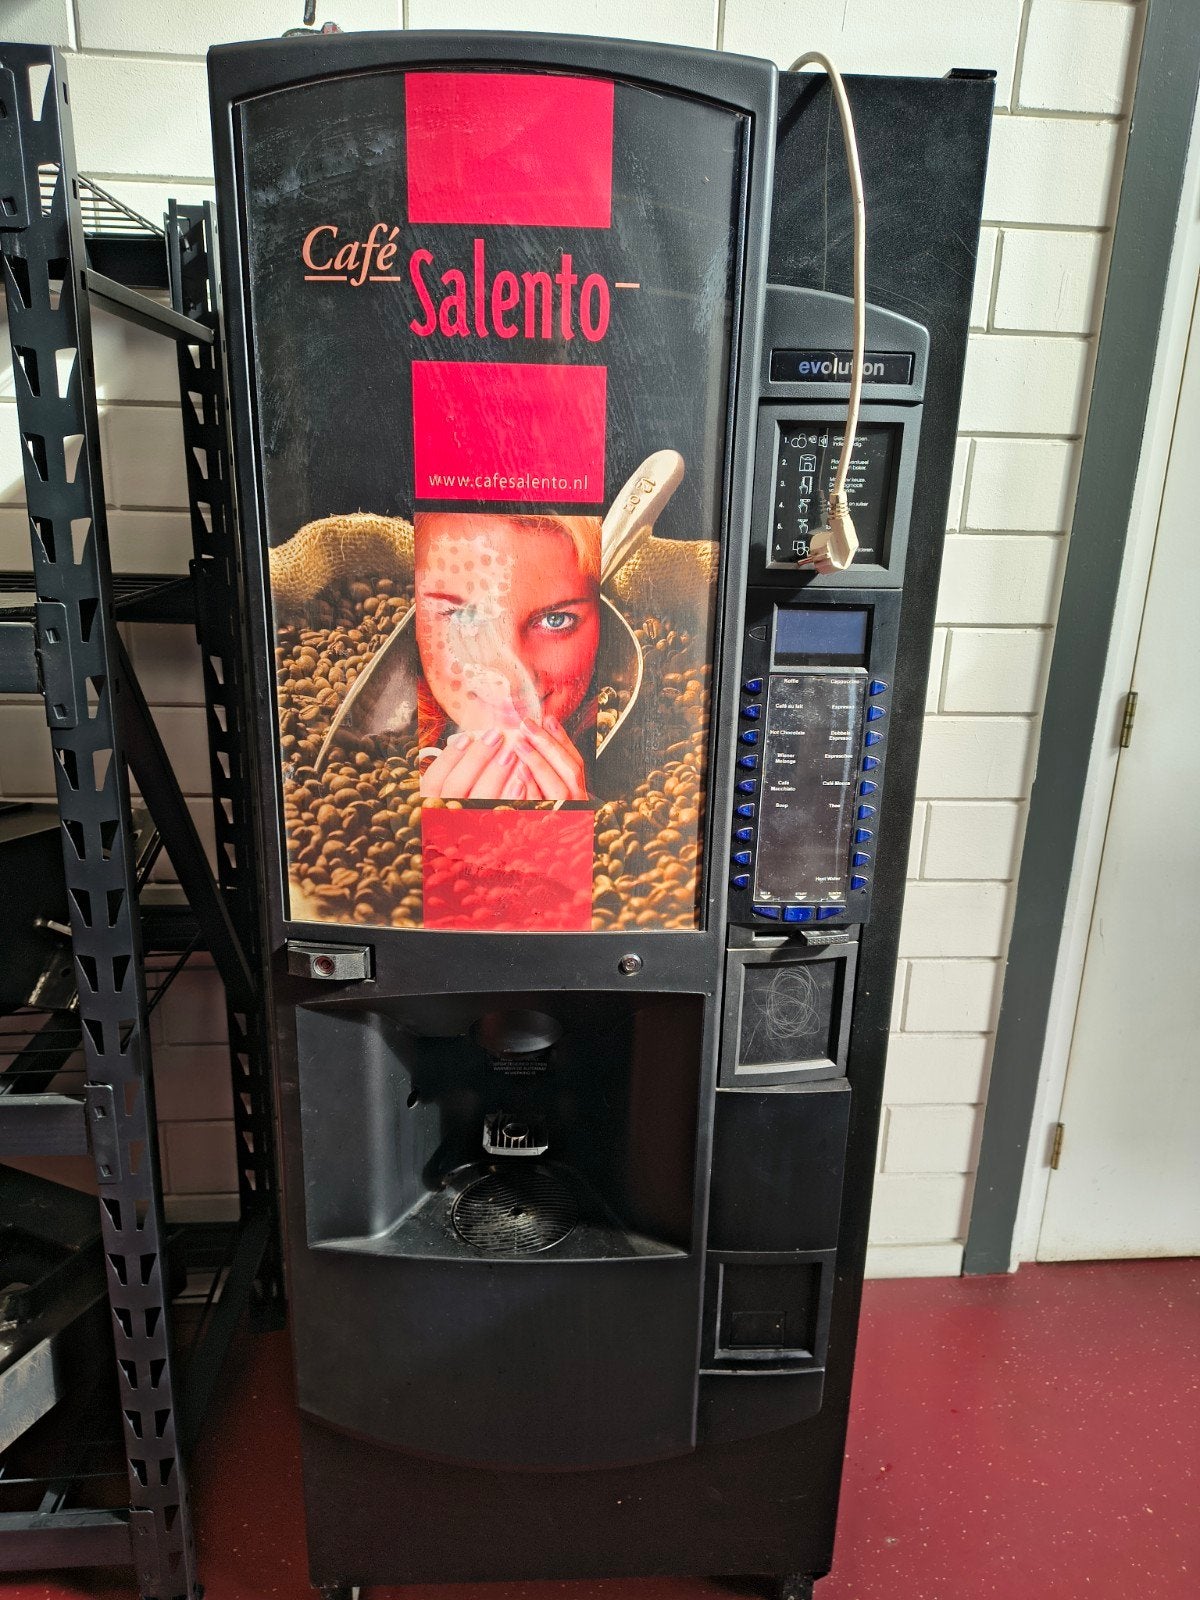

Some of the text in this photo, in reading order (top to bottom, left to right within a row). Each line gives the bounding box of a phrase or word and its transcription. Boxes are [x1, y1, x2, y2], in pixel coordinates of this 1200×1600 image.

[302, 223, 400, 287] Café
[409, 238, 611, 343] Salento
[798, 358, 885, 376] evoluon
[428, 473, 589, 490] www.cafesalento.nl
